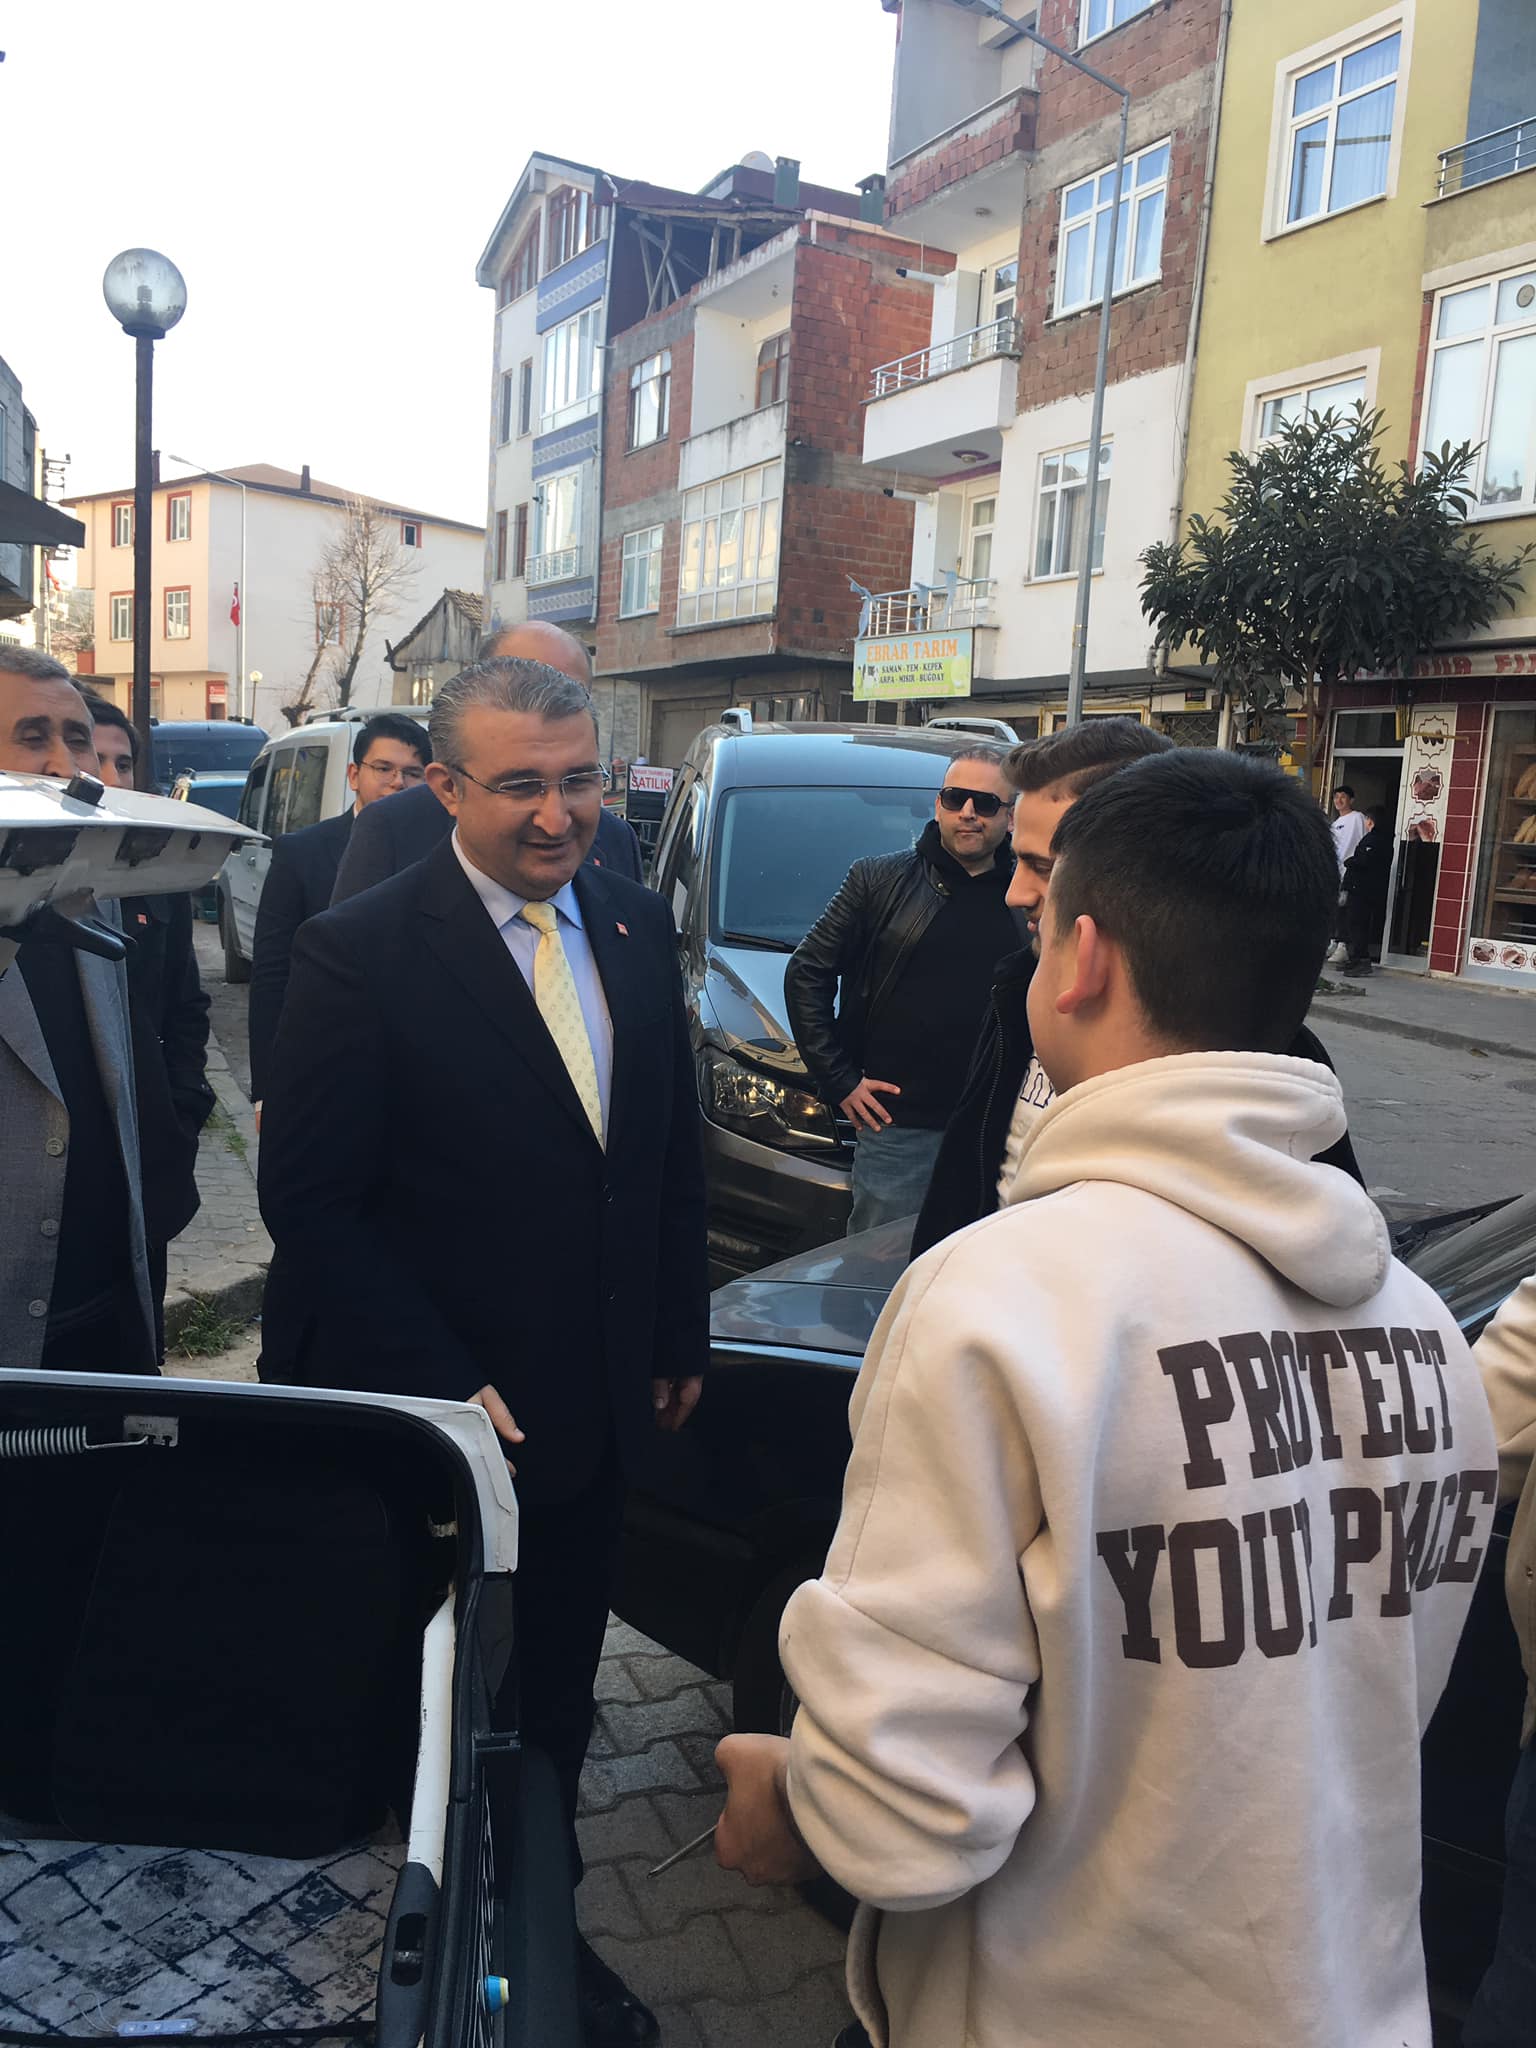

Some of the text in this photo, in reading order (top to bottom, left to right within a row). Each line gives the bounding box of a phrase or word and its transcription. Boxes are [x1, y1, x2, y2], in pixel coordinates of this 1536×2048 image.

[867, 639, 958, 662] EBRAR TARIM
[881, 662, 944, 675] SAMAN YEM KEPEK
[880, 672, 945, 685] ARPA MISIR BUĞDAY
[632, 776, 671, 789] SATILIK
[1157, 1327, 1453, 1490] PROTECT
